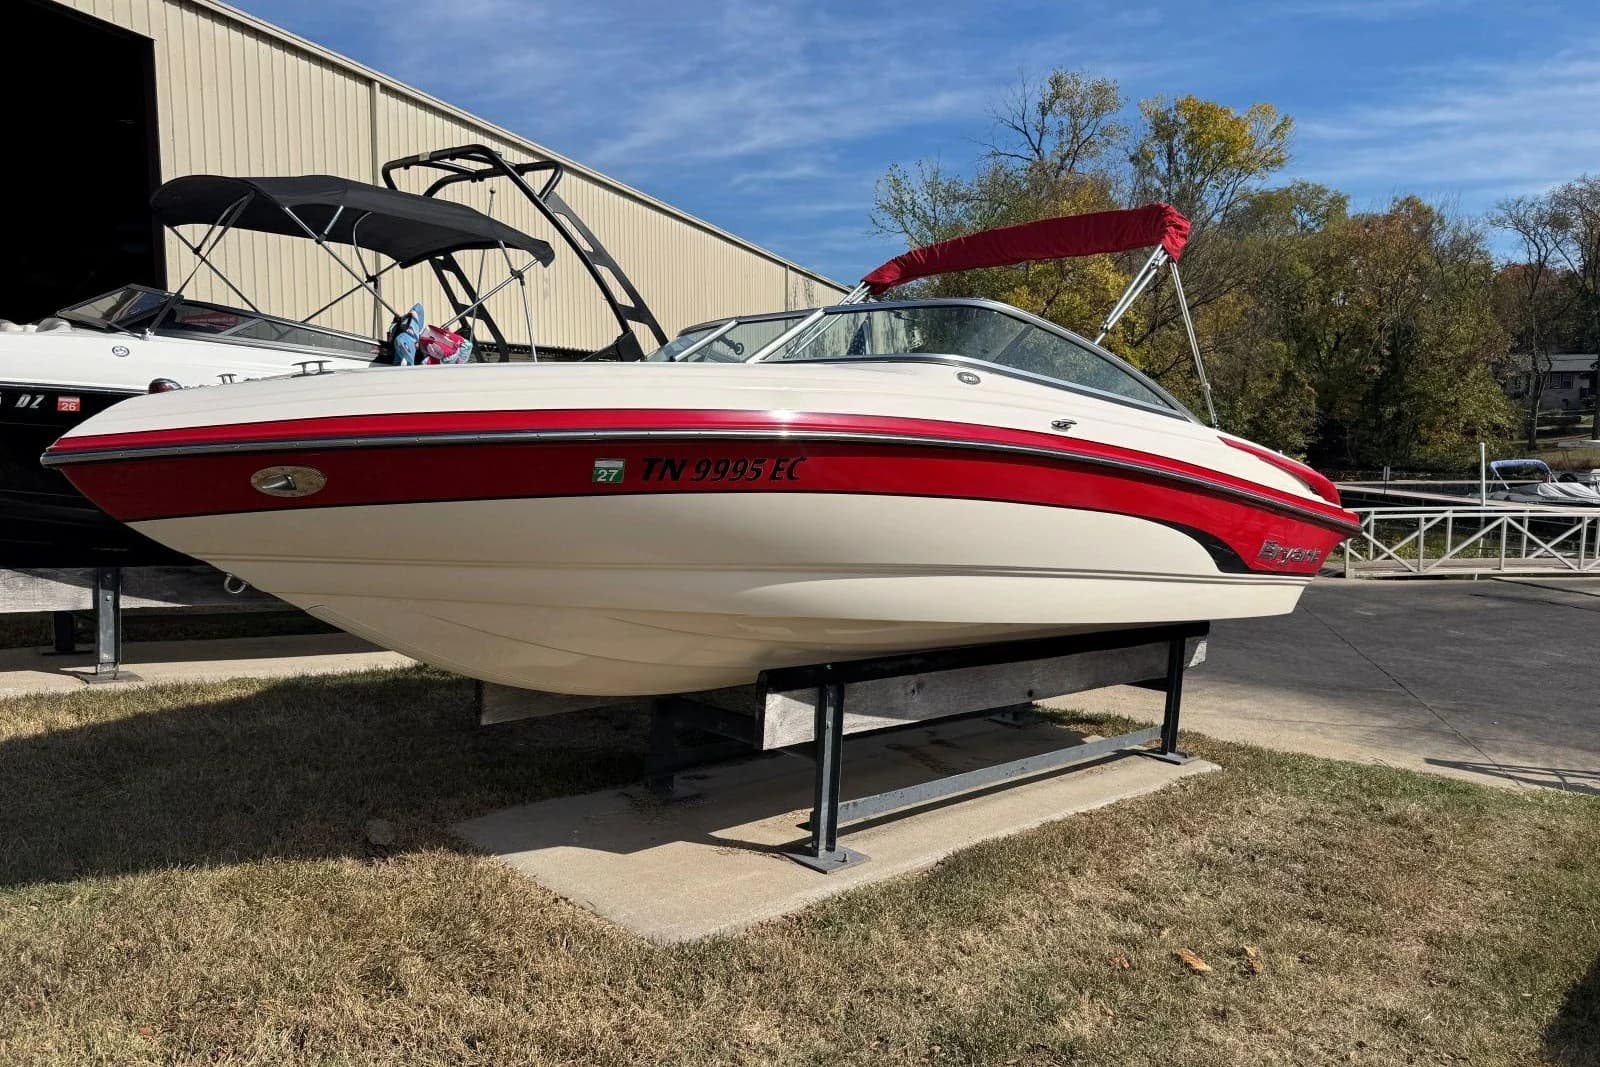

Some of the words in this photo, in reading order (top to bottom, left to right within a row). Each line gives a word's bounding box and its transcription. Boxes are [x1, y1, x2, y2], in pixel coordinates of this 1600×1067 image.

[15, 394, 45, 409] DZ
[61, 402, 77, 411] 26
[597, 469, 619, 482] 27
[642, 457, 688, 481] TN
[690, 456, 767, 482] 9995
[769, 456, 807, 481] EC
